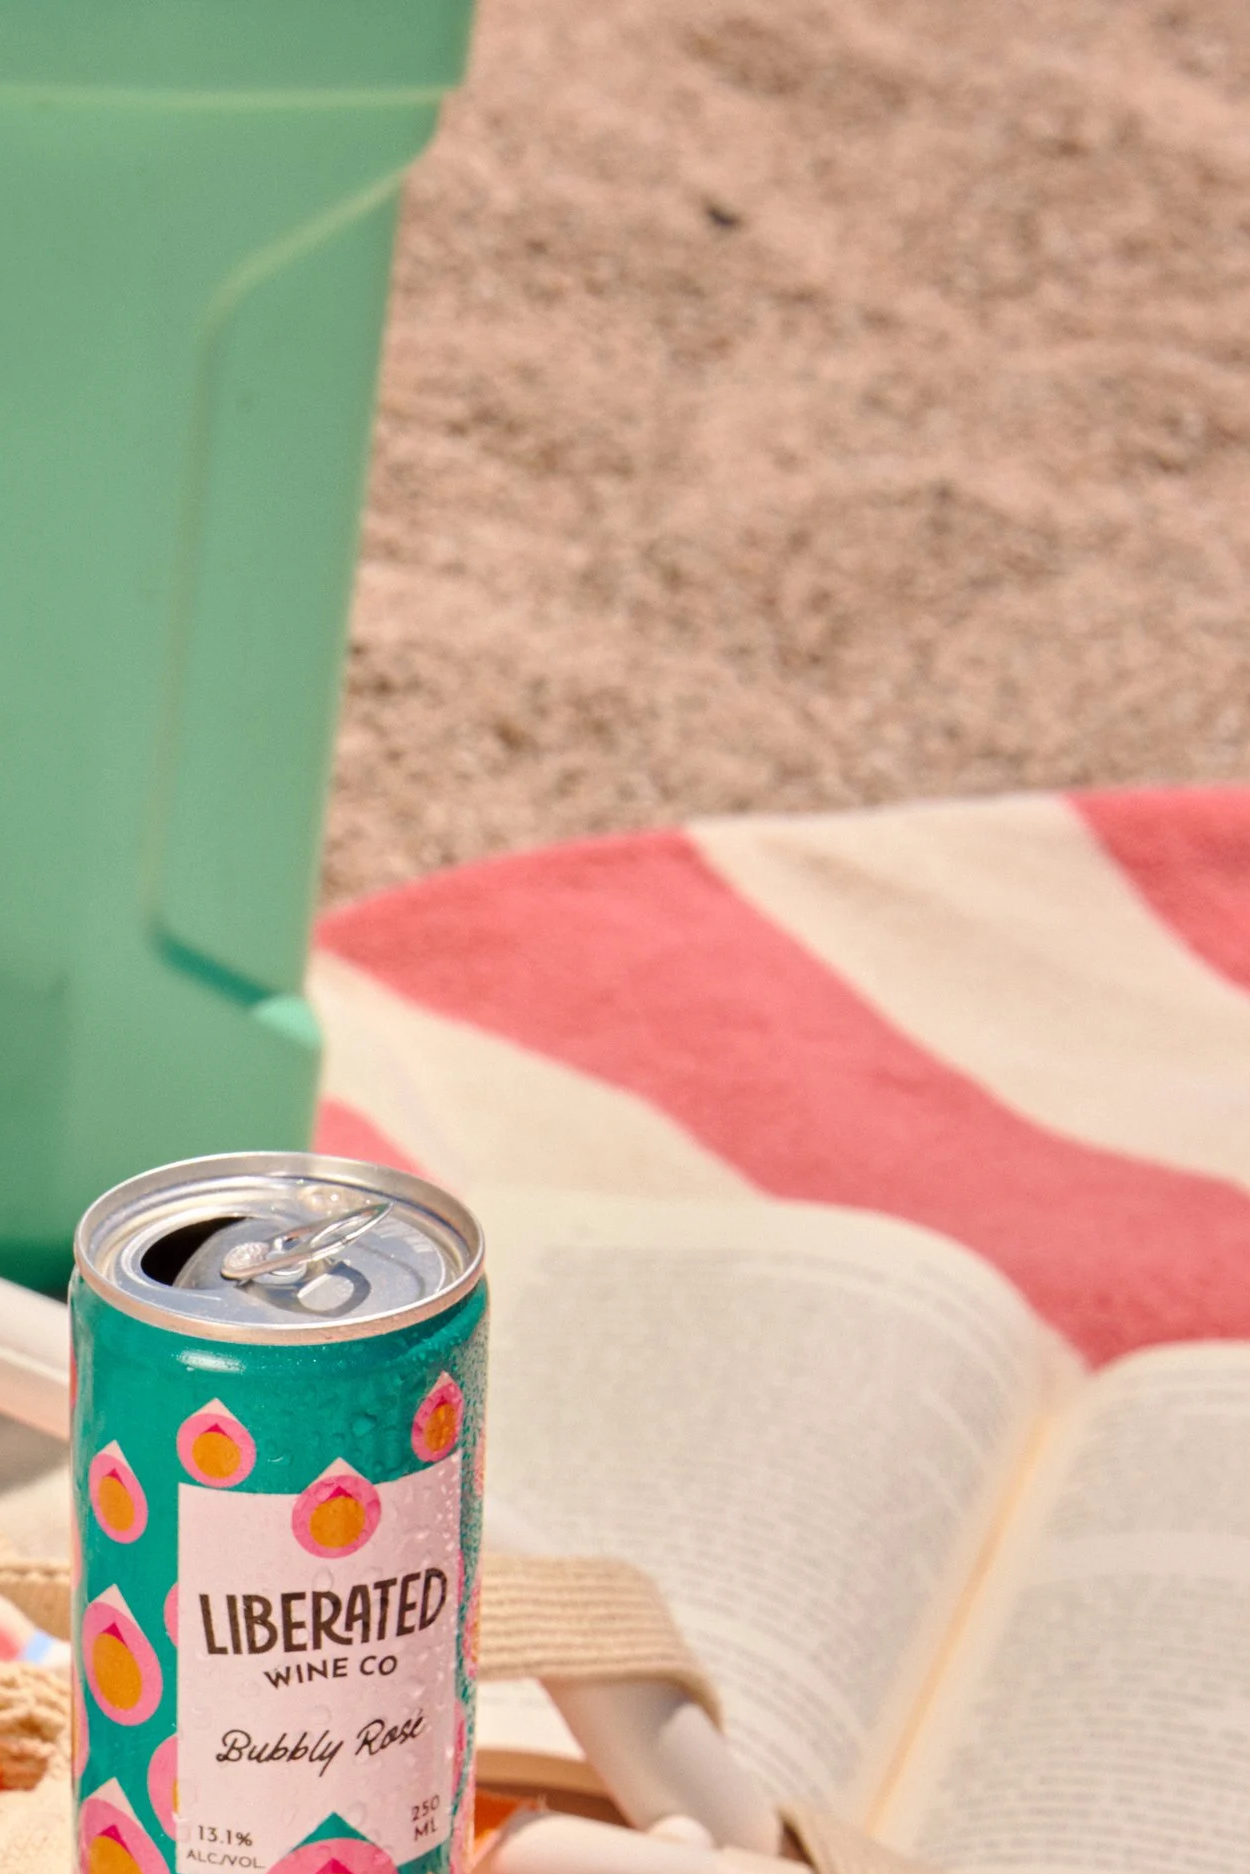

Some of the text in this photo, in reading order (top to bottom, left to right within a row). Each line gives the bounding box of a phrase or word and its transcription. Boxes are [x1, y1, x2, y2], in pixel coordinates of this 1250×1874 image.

[199, 1567, 448, 1655] LIBERATED
[264, 1655, 398, 1689] WINE CO
[216, 1729, 344, 1777] Bubbly
[411, 1795, 440, 1822] 250
[198, 1825, 253, 1847] 13.1%
[413, 1819, 438, 1841] ML
